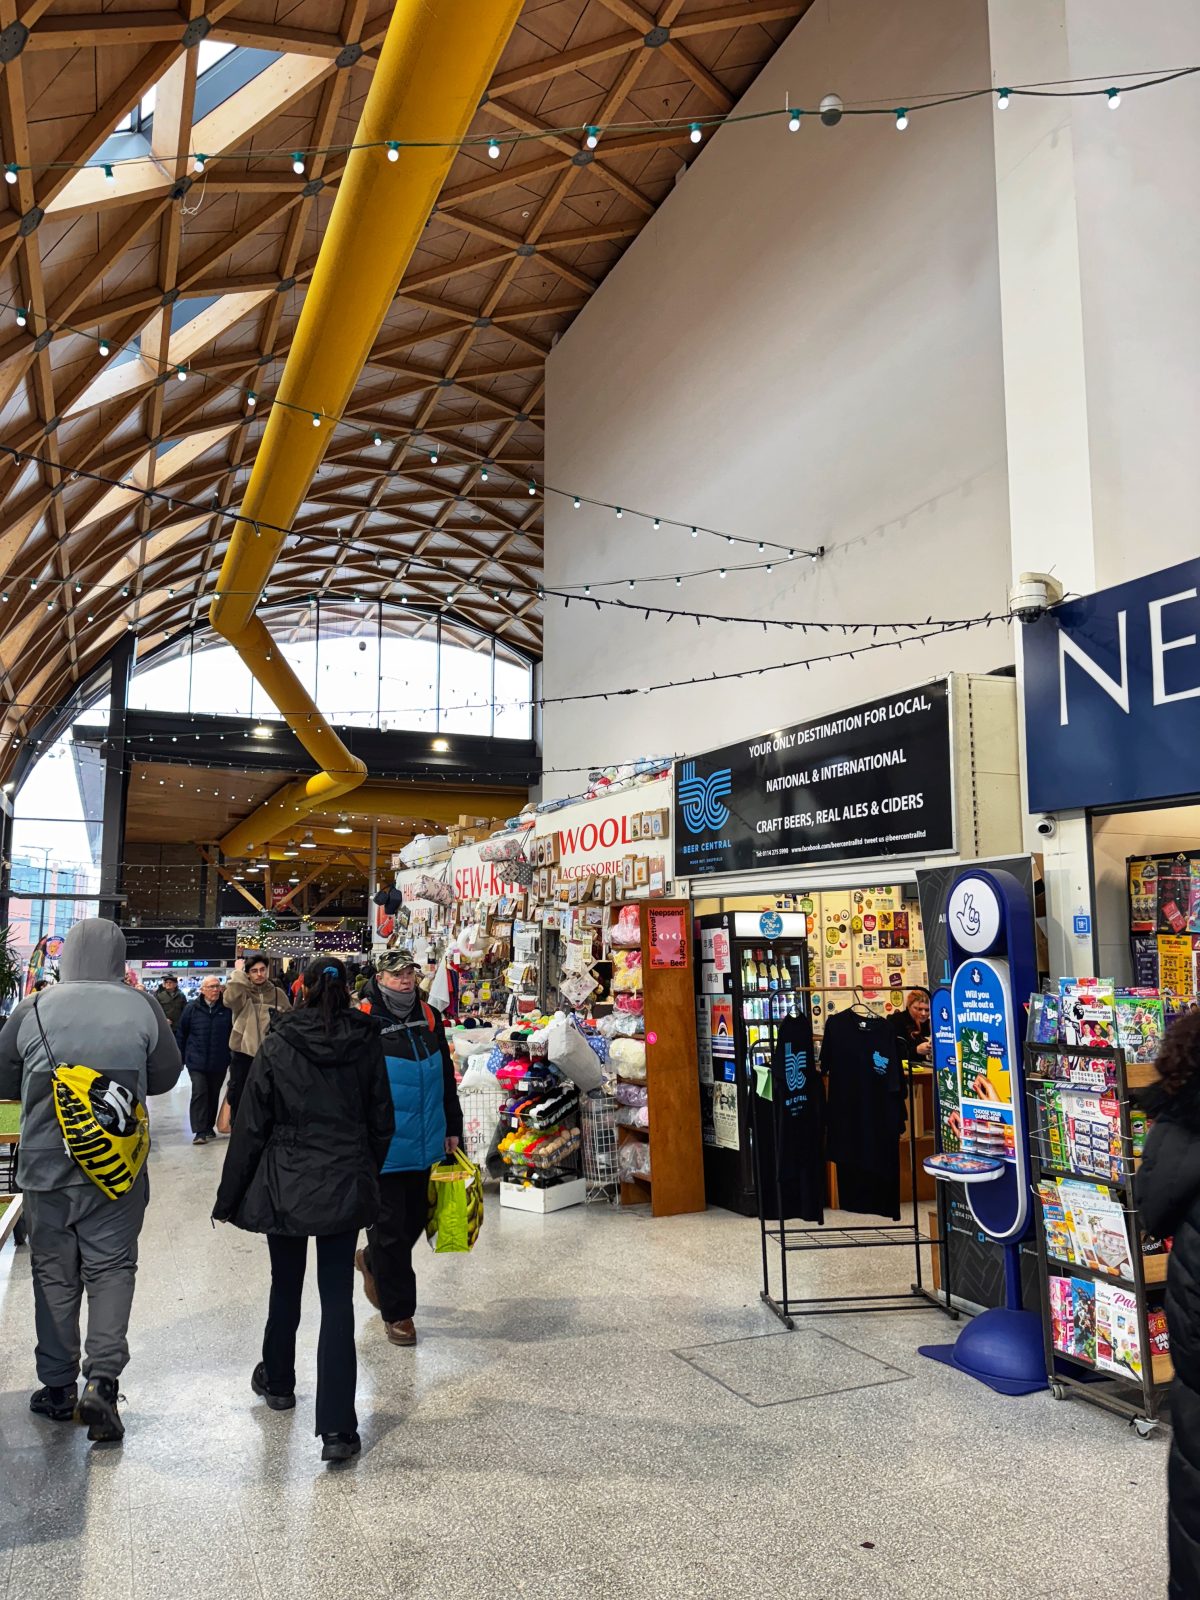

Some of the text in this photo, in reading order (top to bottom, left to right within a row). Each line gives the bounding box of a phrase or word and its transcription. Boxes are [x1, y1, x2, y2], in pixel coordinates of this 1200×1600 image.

[1058, 587, 1200, 726] NE
[748, 694, 931, 758] YOUR ONLY DESTINATION FOR LOCAL,
[766, 748, 907, 792] NATIONAL & INTERNATIONAL
[756, 792, 924, 834] CRAFT BEERS, REAL ALES & CIDERS
[558, 815, 633, 855] WOOL
[864, 836, 879, 845] tweet
[682, 838, 732, 855] BEER CENTRAL
[563, 860, 625, 879] ACCESSORIE
[649, 908, 684, 918] Neepsend
[650, 916, 658, 947] Festival
[164, 933, 195, 948] K&G
[670, 959, 686, 967] Beer
[965, 990, 990, 1000] Will you
[962, 1000, 978, 1009] walk
[978, 1001, 989, 1009] out
[957, 1008, 1003, 1027] winner?
[967, 1063, 987, 1075] MILLION
[1085, 1101, 1096, 1109] EFL
